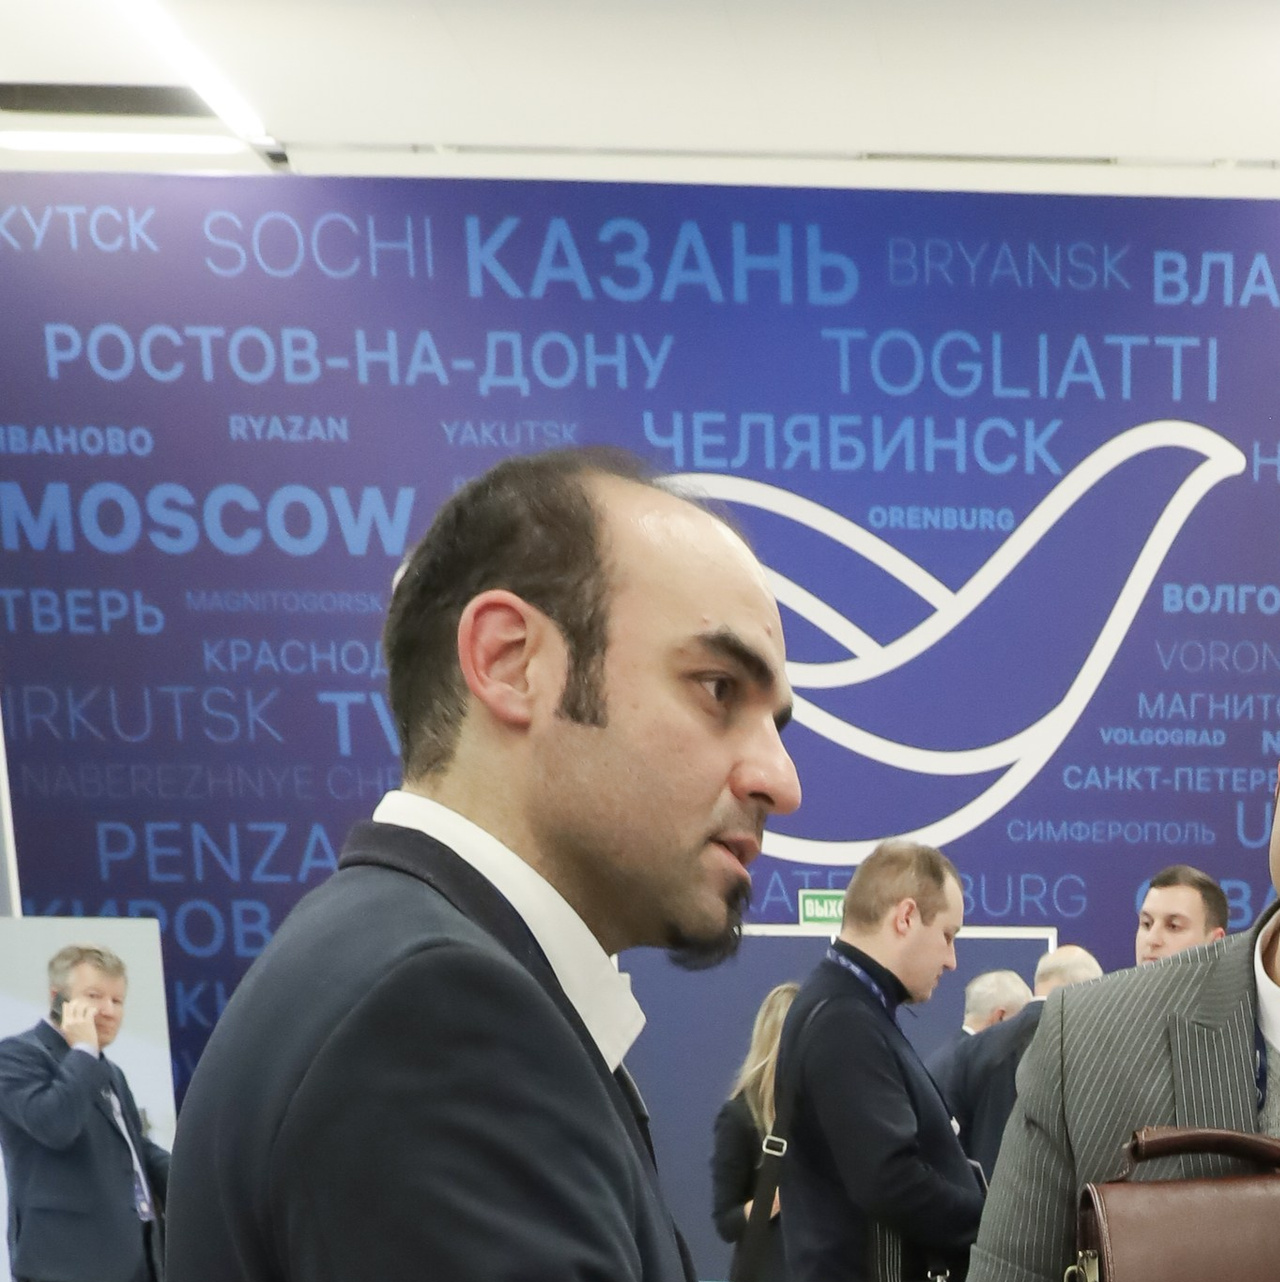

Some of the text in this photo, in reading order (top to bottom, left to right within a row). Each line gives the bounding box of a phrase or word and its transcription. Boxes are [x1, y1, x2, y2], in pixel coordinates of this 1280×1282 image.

[203, 210, 435, 280] SOCHI
[464, 215, 860, 306] КАЗАНЬ
[886, 236, 1132, 291] BRYANSK
[44, 323, 674, 397] РОСТОВ-НА-ДОНУ
[820, 328, 1218, 402] TOGLIATTI
[230, 414, 349, 443] RYAZAN
[441, 420, 579, 448] YAKUTSK
[641, 410, 1064, 477] ЧЕЛЯБИНСК
[0, 480, 416, 558] MOSCOW
[867, 504, 1016, 533] ORENBURG
[0, 587, 166, 636] ТВЕРЬ
[185, 589, 384, 614] MAGNITOGORSK
[1, 684, 286, 746] IRKUTSK
[1099, 726, 1227, 748] VOLGOGRAD
[20, 762, 313, 802] NABEREZHNYE
[96, 821, 339, 884] PENZA
[1006, 818, 1217, 846] СИМФЕРОПОЛЬ
